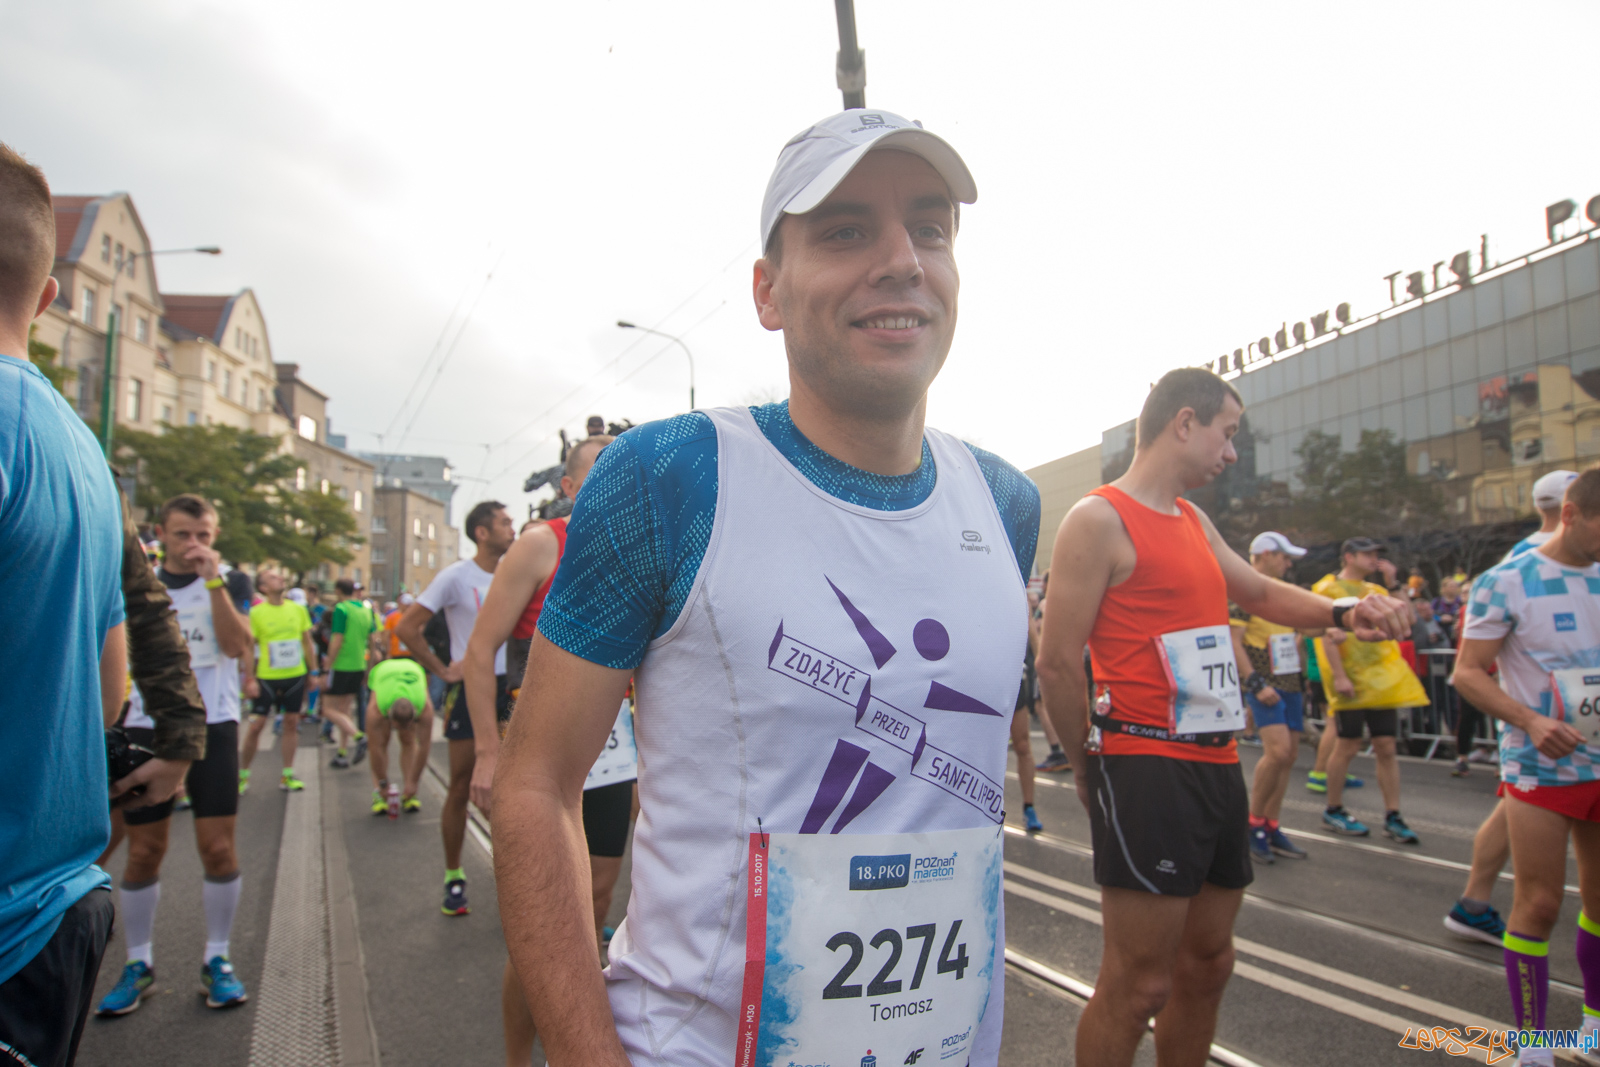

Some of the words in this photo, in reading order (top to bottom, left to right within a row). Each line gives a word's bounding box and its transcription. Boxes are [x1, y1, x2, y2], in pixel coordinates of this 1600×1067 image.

[783, 647, 857, 696] ZDĄŻYĆ
[870, 709, 911, 742] PRZED
[927, 756, 1003, 815] SANFILIPPO
[754, 853, 763, 898] 15.10.2017
[856, 866, 876, 880] 18.
[878, 864, 906, 879] PKO
[913, 866, 954, 880] maraton
[822, 919, 969, 1000] 2274
[746, 1004, 756, 1023] M30
[869, 998, 934, 1022] Tomasz
